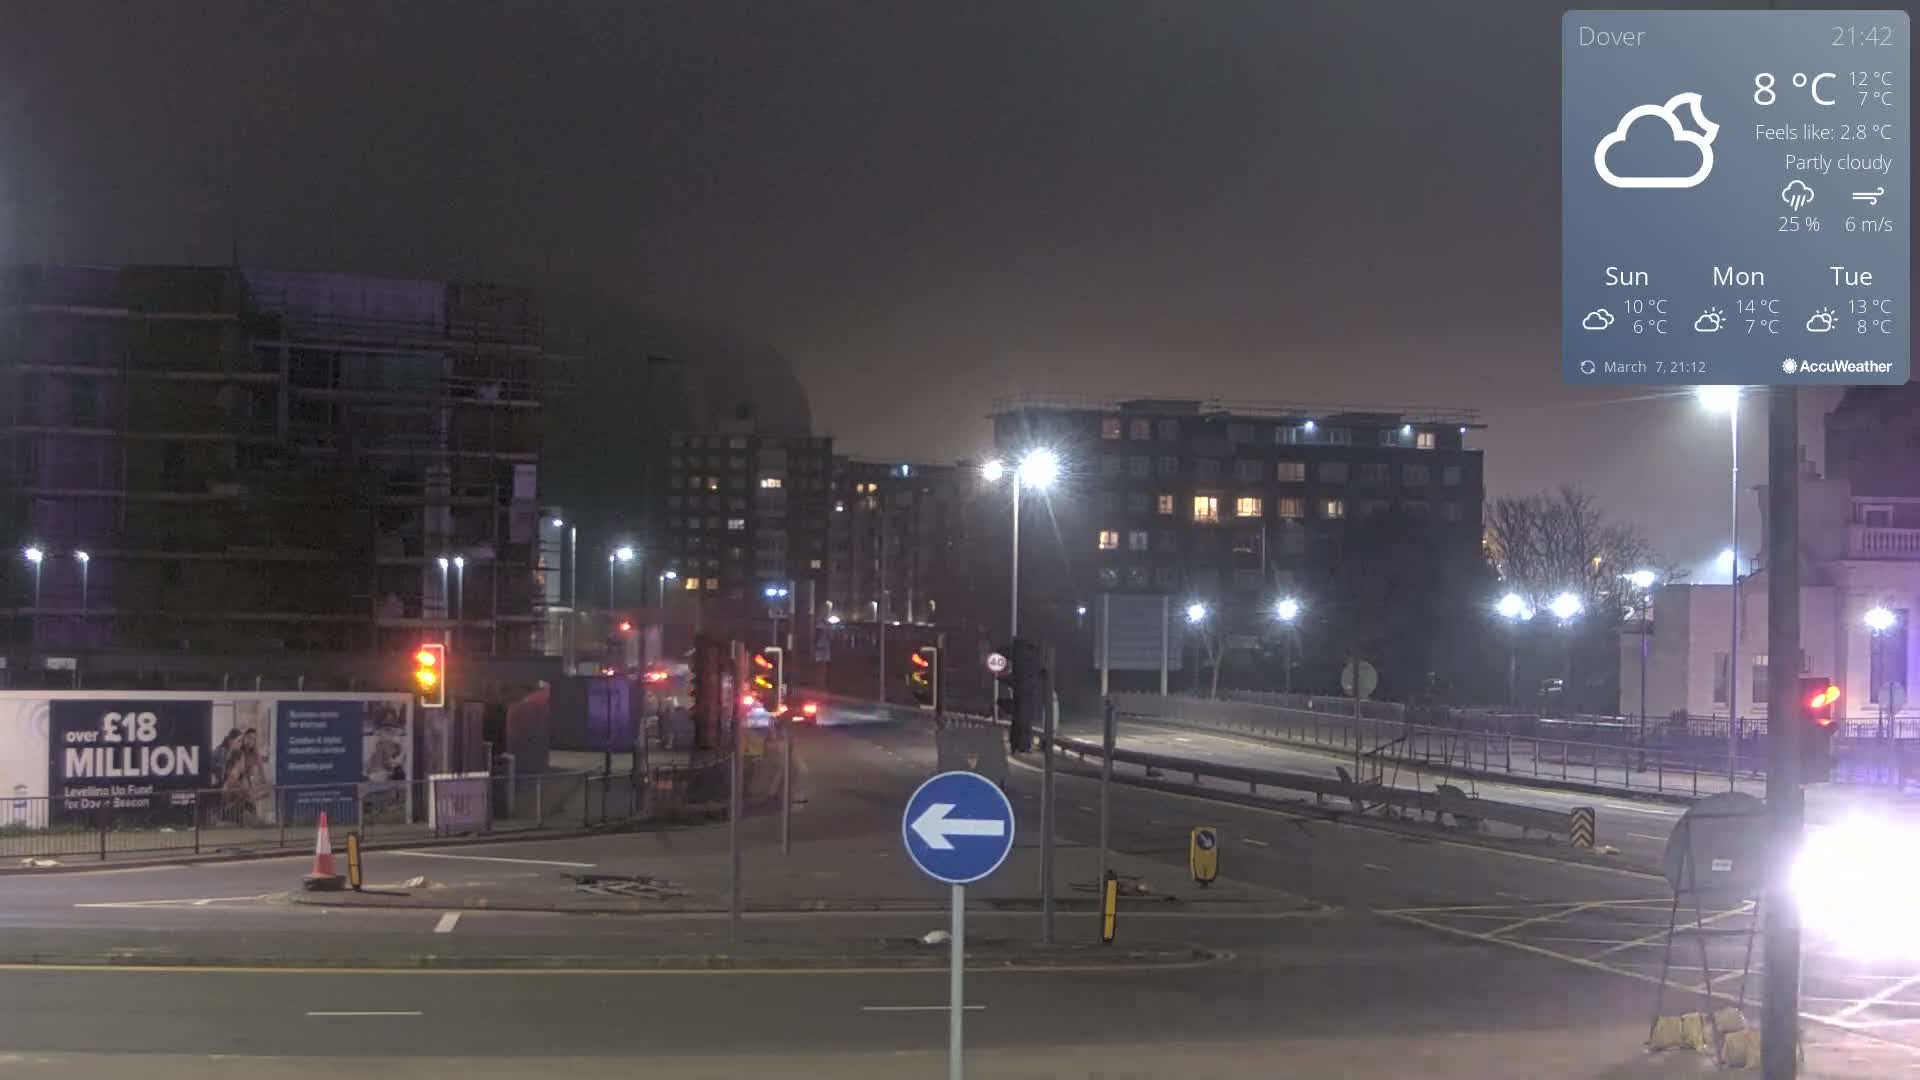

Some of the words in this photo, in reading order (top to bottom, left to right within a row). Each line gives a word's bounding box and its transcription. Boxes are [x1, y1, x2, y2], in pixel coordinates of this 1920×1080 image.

[65, 731, 99, 743] over
[103, 711, 157, 742] £18
[65, 745, 200, 778] MILLION
